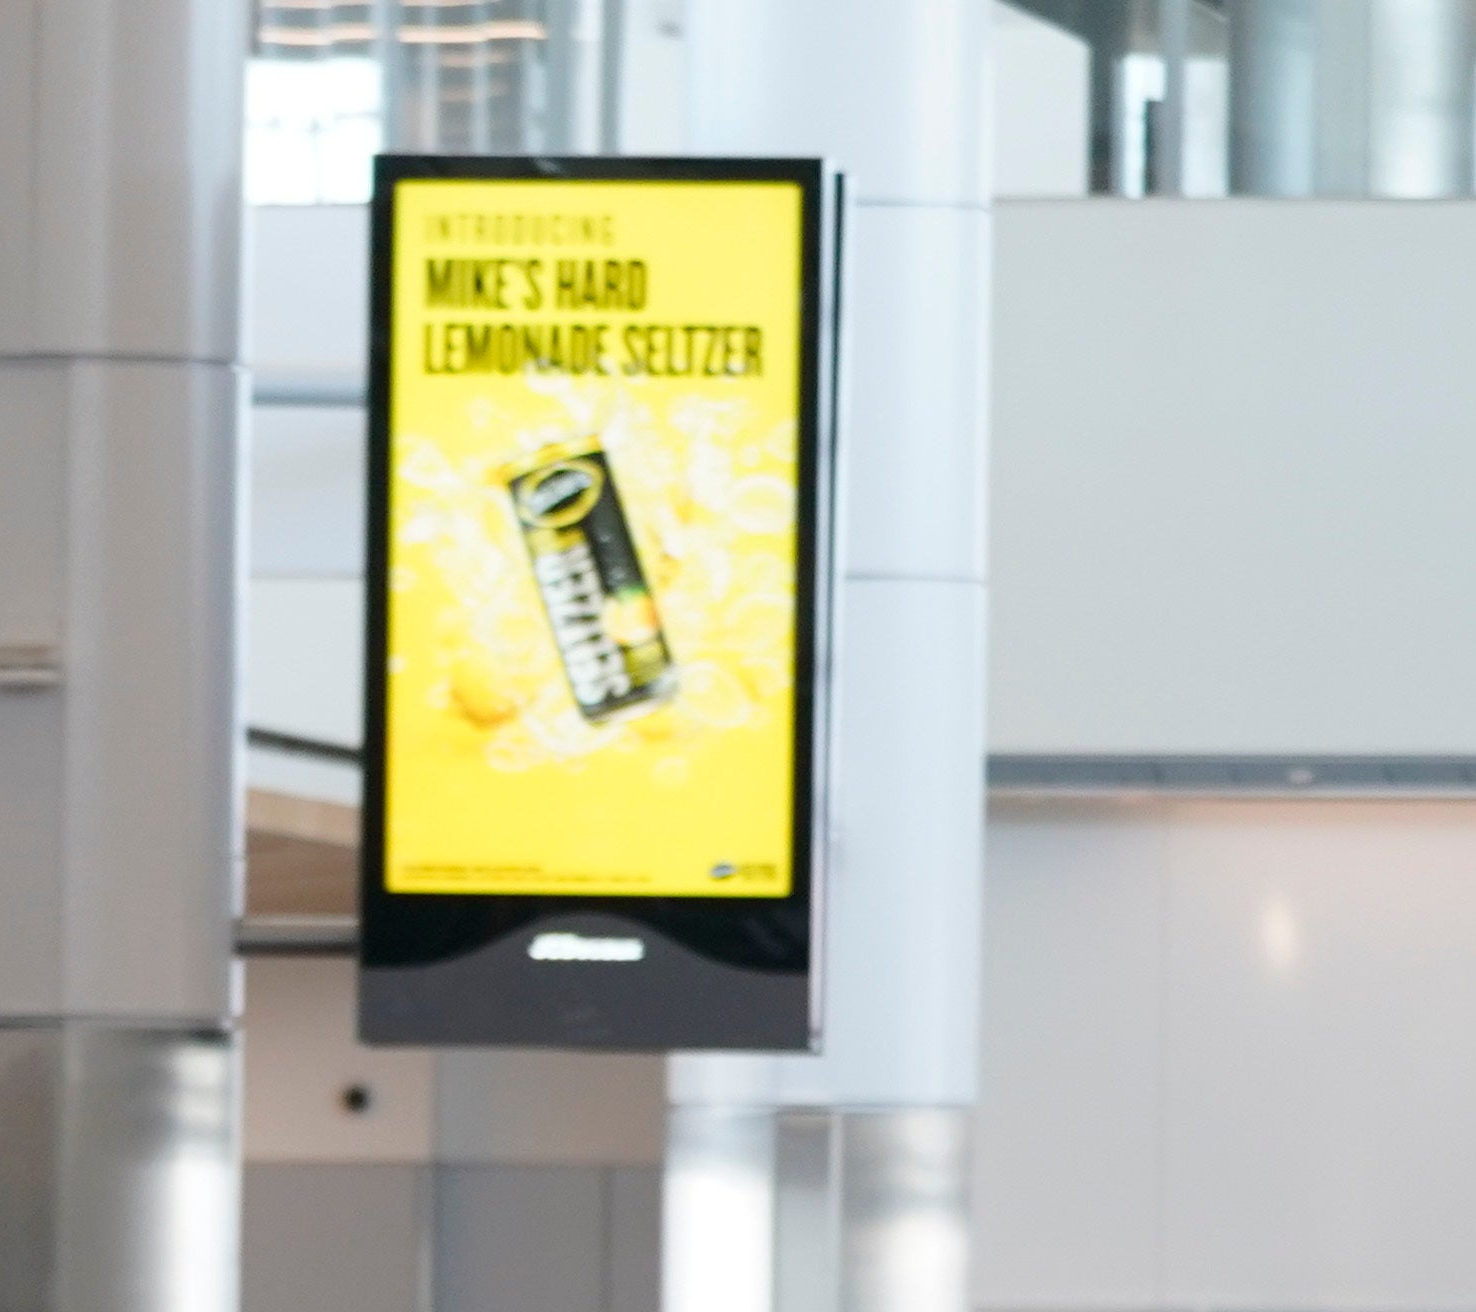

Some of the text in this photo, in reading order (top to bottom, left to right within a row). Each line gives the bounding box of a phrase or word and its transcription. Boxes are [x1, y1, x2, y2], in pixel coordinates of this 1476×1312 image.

[423, 213, 616, 246] INTRODUCING
[425, 258, 647, 311] MIKE'S HARD
[423, 323, 763, 378] LEMONADE SELTZER
